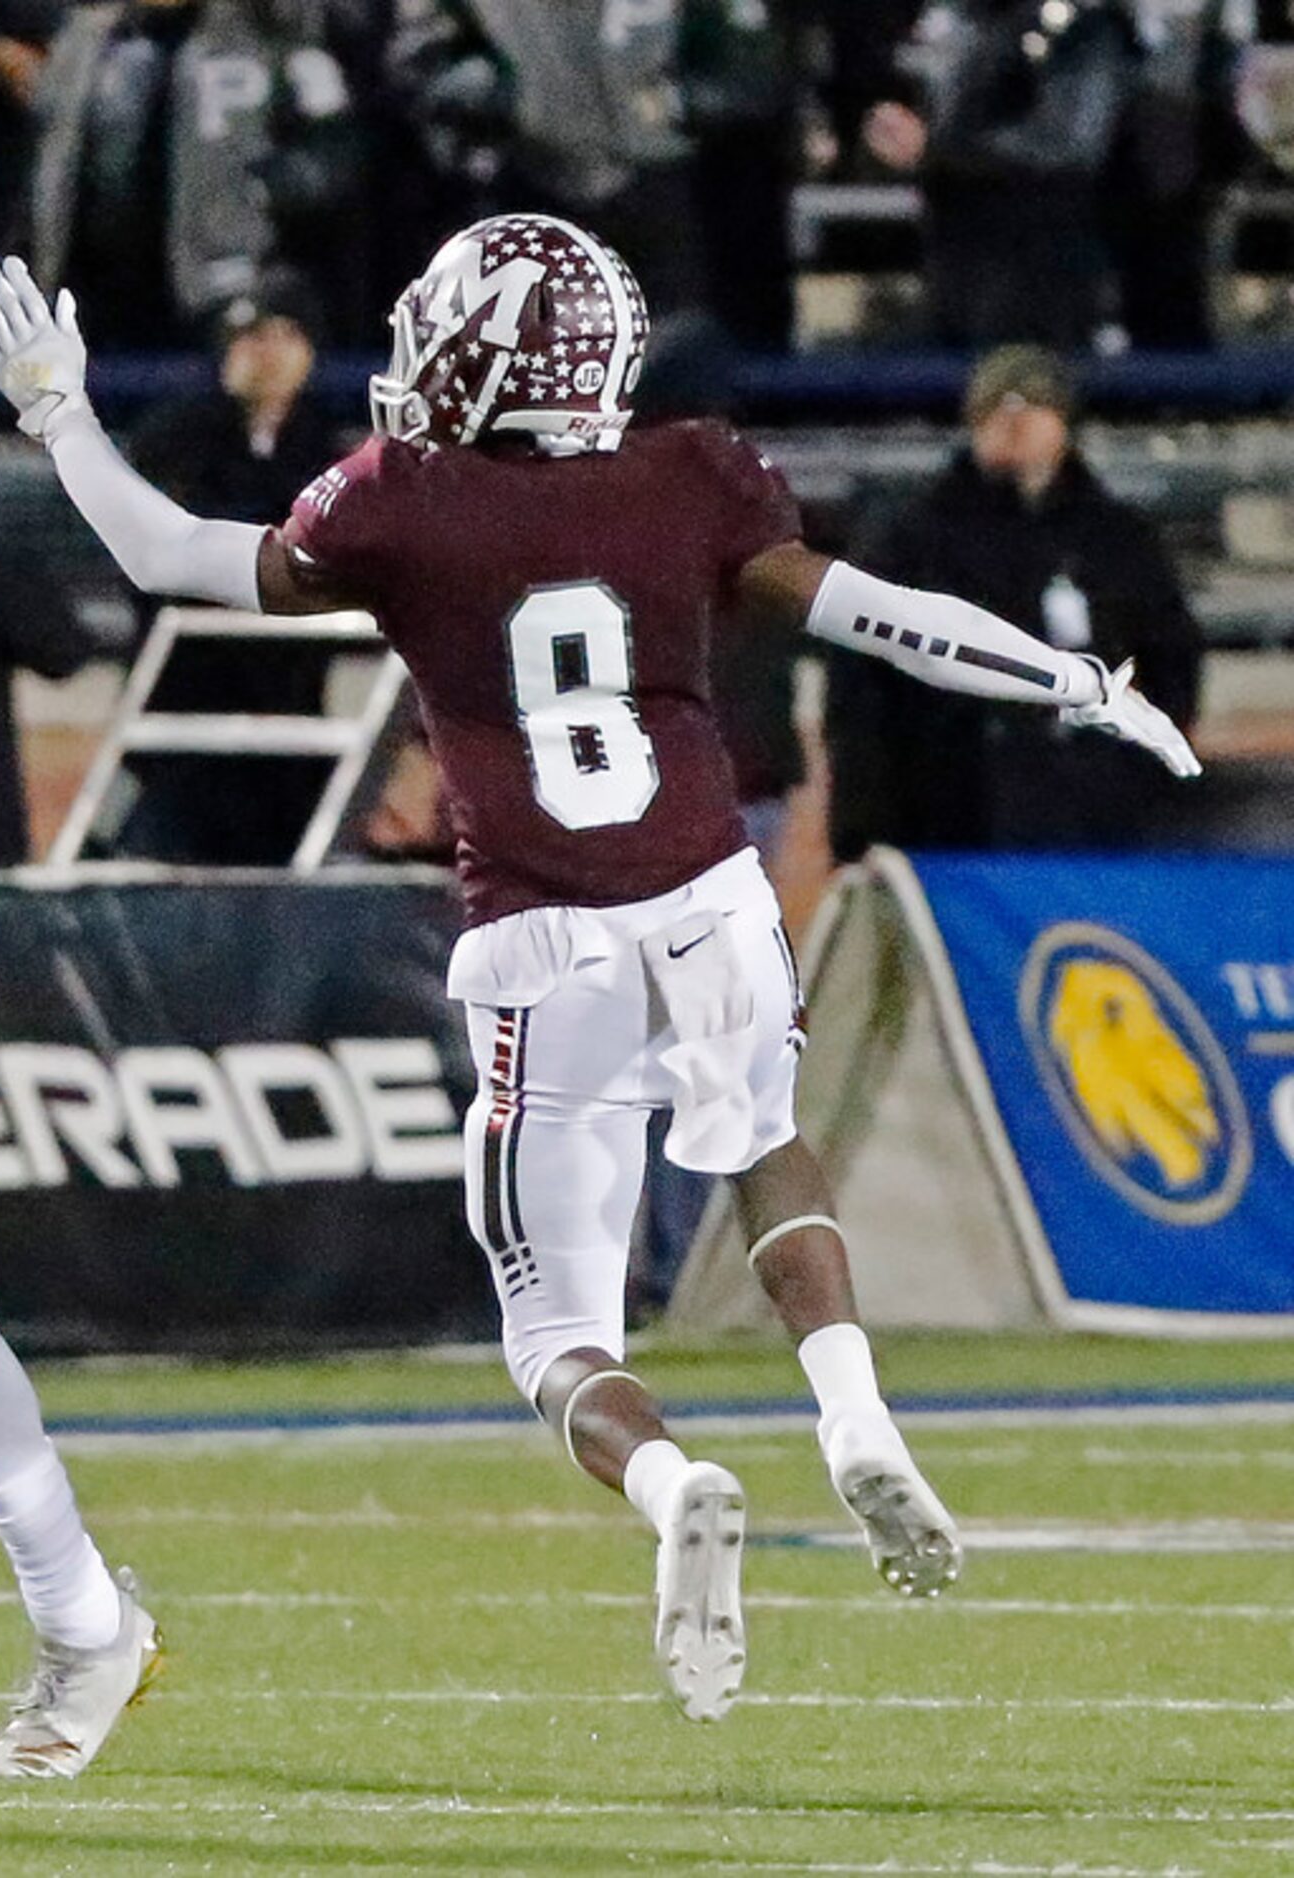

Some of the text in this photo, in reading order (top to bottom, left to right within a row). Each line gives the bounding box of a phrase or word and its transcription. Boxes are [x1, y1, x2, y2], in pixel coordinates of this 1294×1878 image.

[425, 236, 548, 350] M
[577, 367, 602, 388] JE
[502, 576, 661, 832] 8
